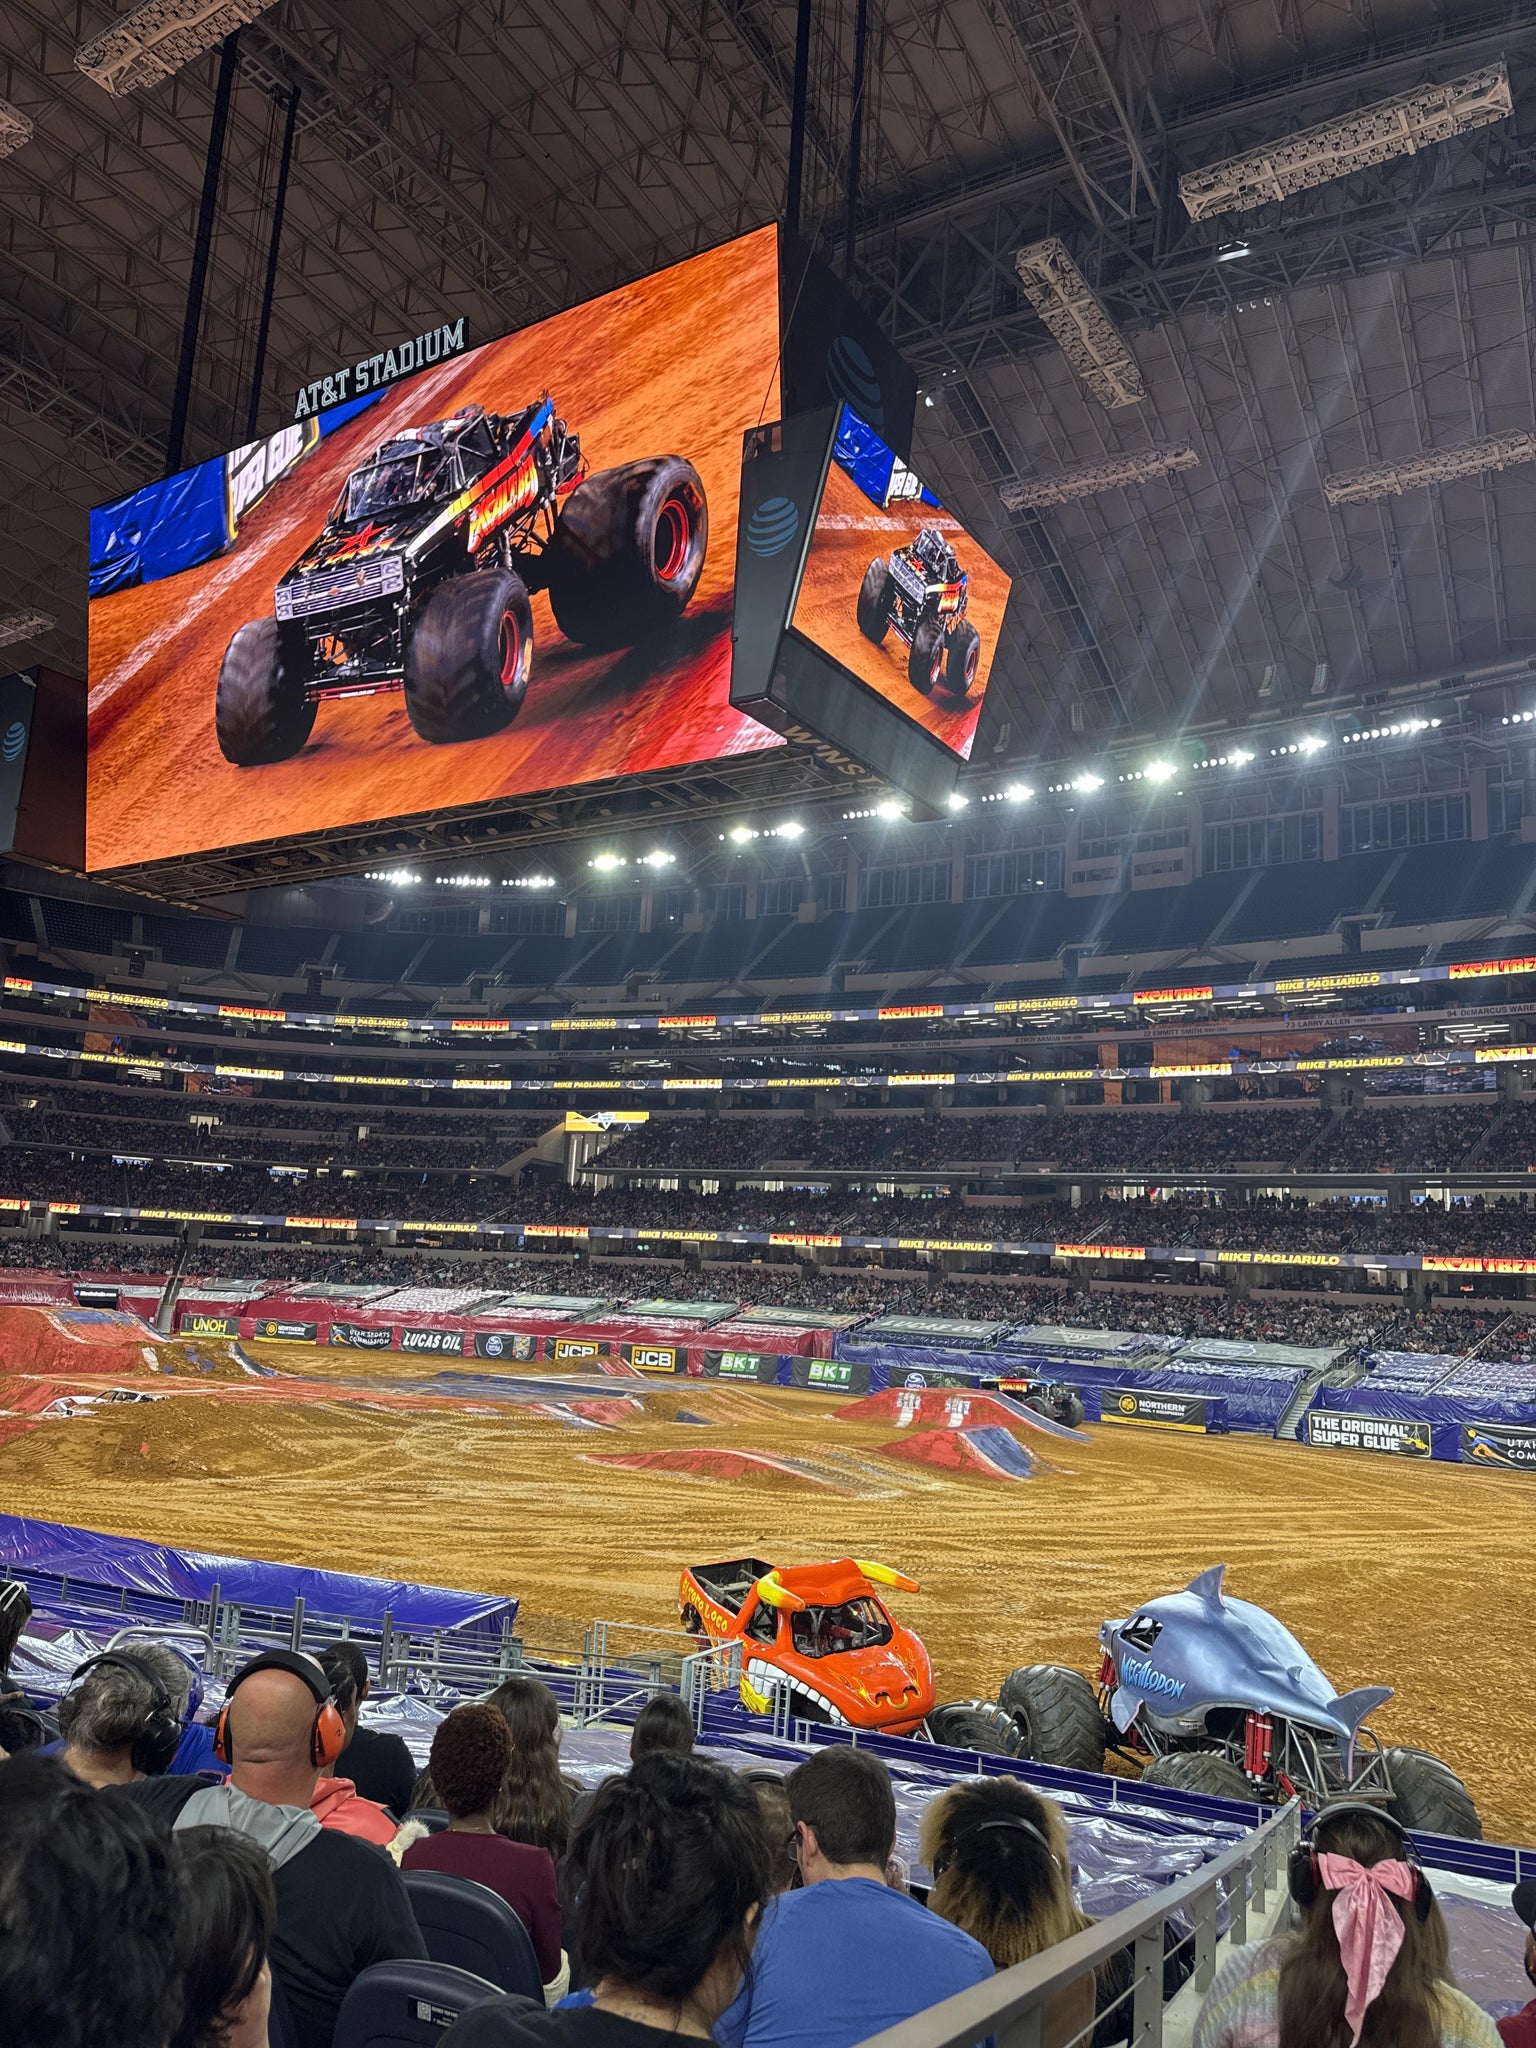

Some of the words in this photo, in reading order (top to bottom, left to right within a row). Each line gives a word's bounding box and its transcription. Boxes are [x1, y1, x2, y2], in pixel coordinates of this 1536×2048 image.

[294, 367, 350, 418] AT&T
[355, 317, 464, 393] STADIUM
[1275, 981, 1303, 992] MIKE
[1306, 974, 1380, 990] PAGLIARULO
[86, 990, 110, 1001] MIKE
[110, 992, 169, 1008] PAGLIARULO
[994, 1002, 1017, 1011] MIKE
[1018, 998, 1079, 1010] PAGLIARULO
[1510, 1003, 1535, 1013] WARE
[335, 1017, 356, 1025] MIKE
[356, 1017, 409, 1028] PAGLIARULO
[570, 1019, 617, 1028] PAGLIARULO
[760, 1014, 781, 1022] MIKE
[781, 1012, 832, 1022] PAGLIARULO
[1298, 1019, 1324, 1028] LARRY
[1324, 1018, 1350, 1027] ALLEN
[1181, 1027, 1202, 1035] SMITH
[80, 1052, 105, 1062] MIKE
[105, 1055, 165, 1068] PAGLIARULO
[1296, 1060, 1325, 1070] MIKE
[1327, 1057, 1404, 1069] PAGLIARULO
[333, 1075, 356, 1083] MIKE
[356, 1076, 409, 1086] PAGLIARULO
[1007, 1072, 1031, 1081] MIKE
[1032, 1070, 1093, 1080] PAGLIARULO
[573, 1080, 621, 1088] PAGLIARULO
[767, 1079, 788, 1087] MIKE
[788, 1078, 841, 1087] PAGLIARULO
[139, 1209, 166, 1219] MIKE
[166, 1210, 232, 1222] PAGLIARULO
[402, 1222, 424, 1230] MIKE
[425, 1223, 478, 1233] PAGLIARULO
[638, 1230, 661, 1239] MIKE
[661, 1231, 718, 1241] PAGLIARULO
[898, 1239, 924, 1248] MIKE
[926, 1240, 993, 1251] PAGLIARULO
[1217, 1252, 1252, 1262] MIKE
[1253, 1253, 1340, 1266] PAGLIARULO
[192, 1316, 228, 1332] UNOH
[348, 1335, 390, 1345] COMMISSION
[402, 1332, 441, 1349] LUCAS
[634, 1351, 672, 1367] JCB
[720, 1354, 760, 1370] BKT
[808, 1362, 851, 1379] BKT
[1139, 1400, 1186, 1412] NORTHERN
[1312, 1416, 1340, 1431] THE
[1312, 1430, 1360, 1446] SUPER
[1363, 1435, 1401, 1451] GLUE
[704, 1603, 728, 1632] LOCO
